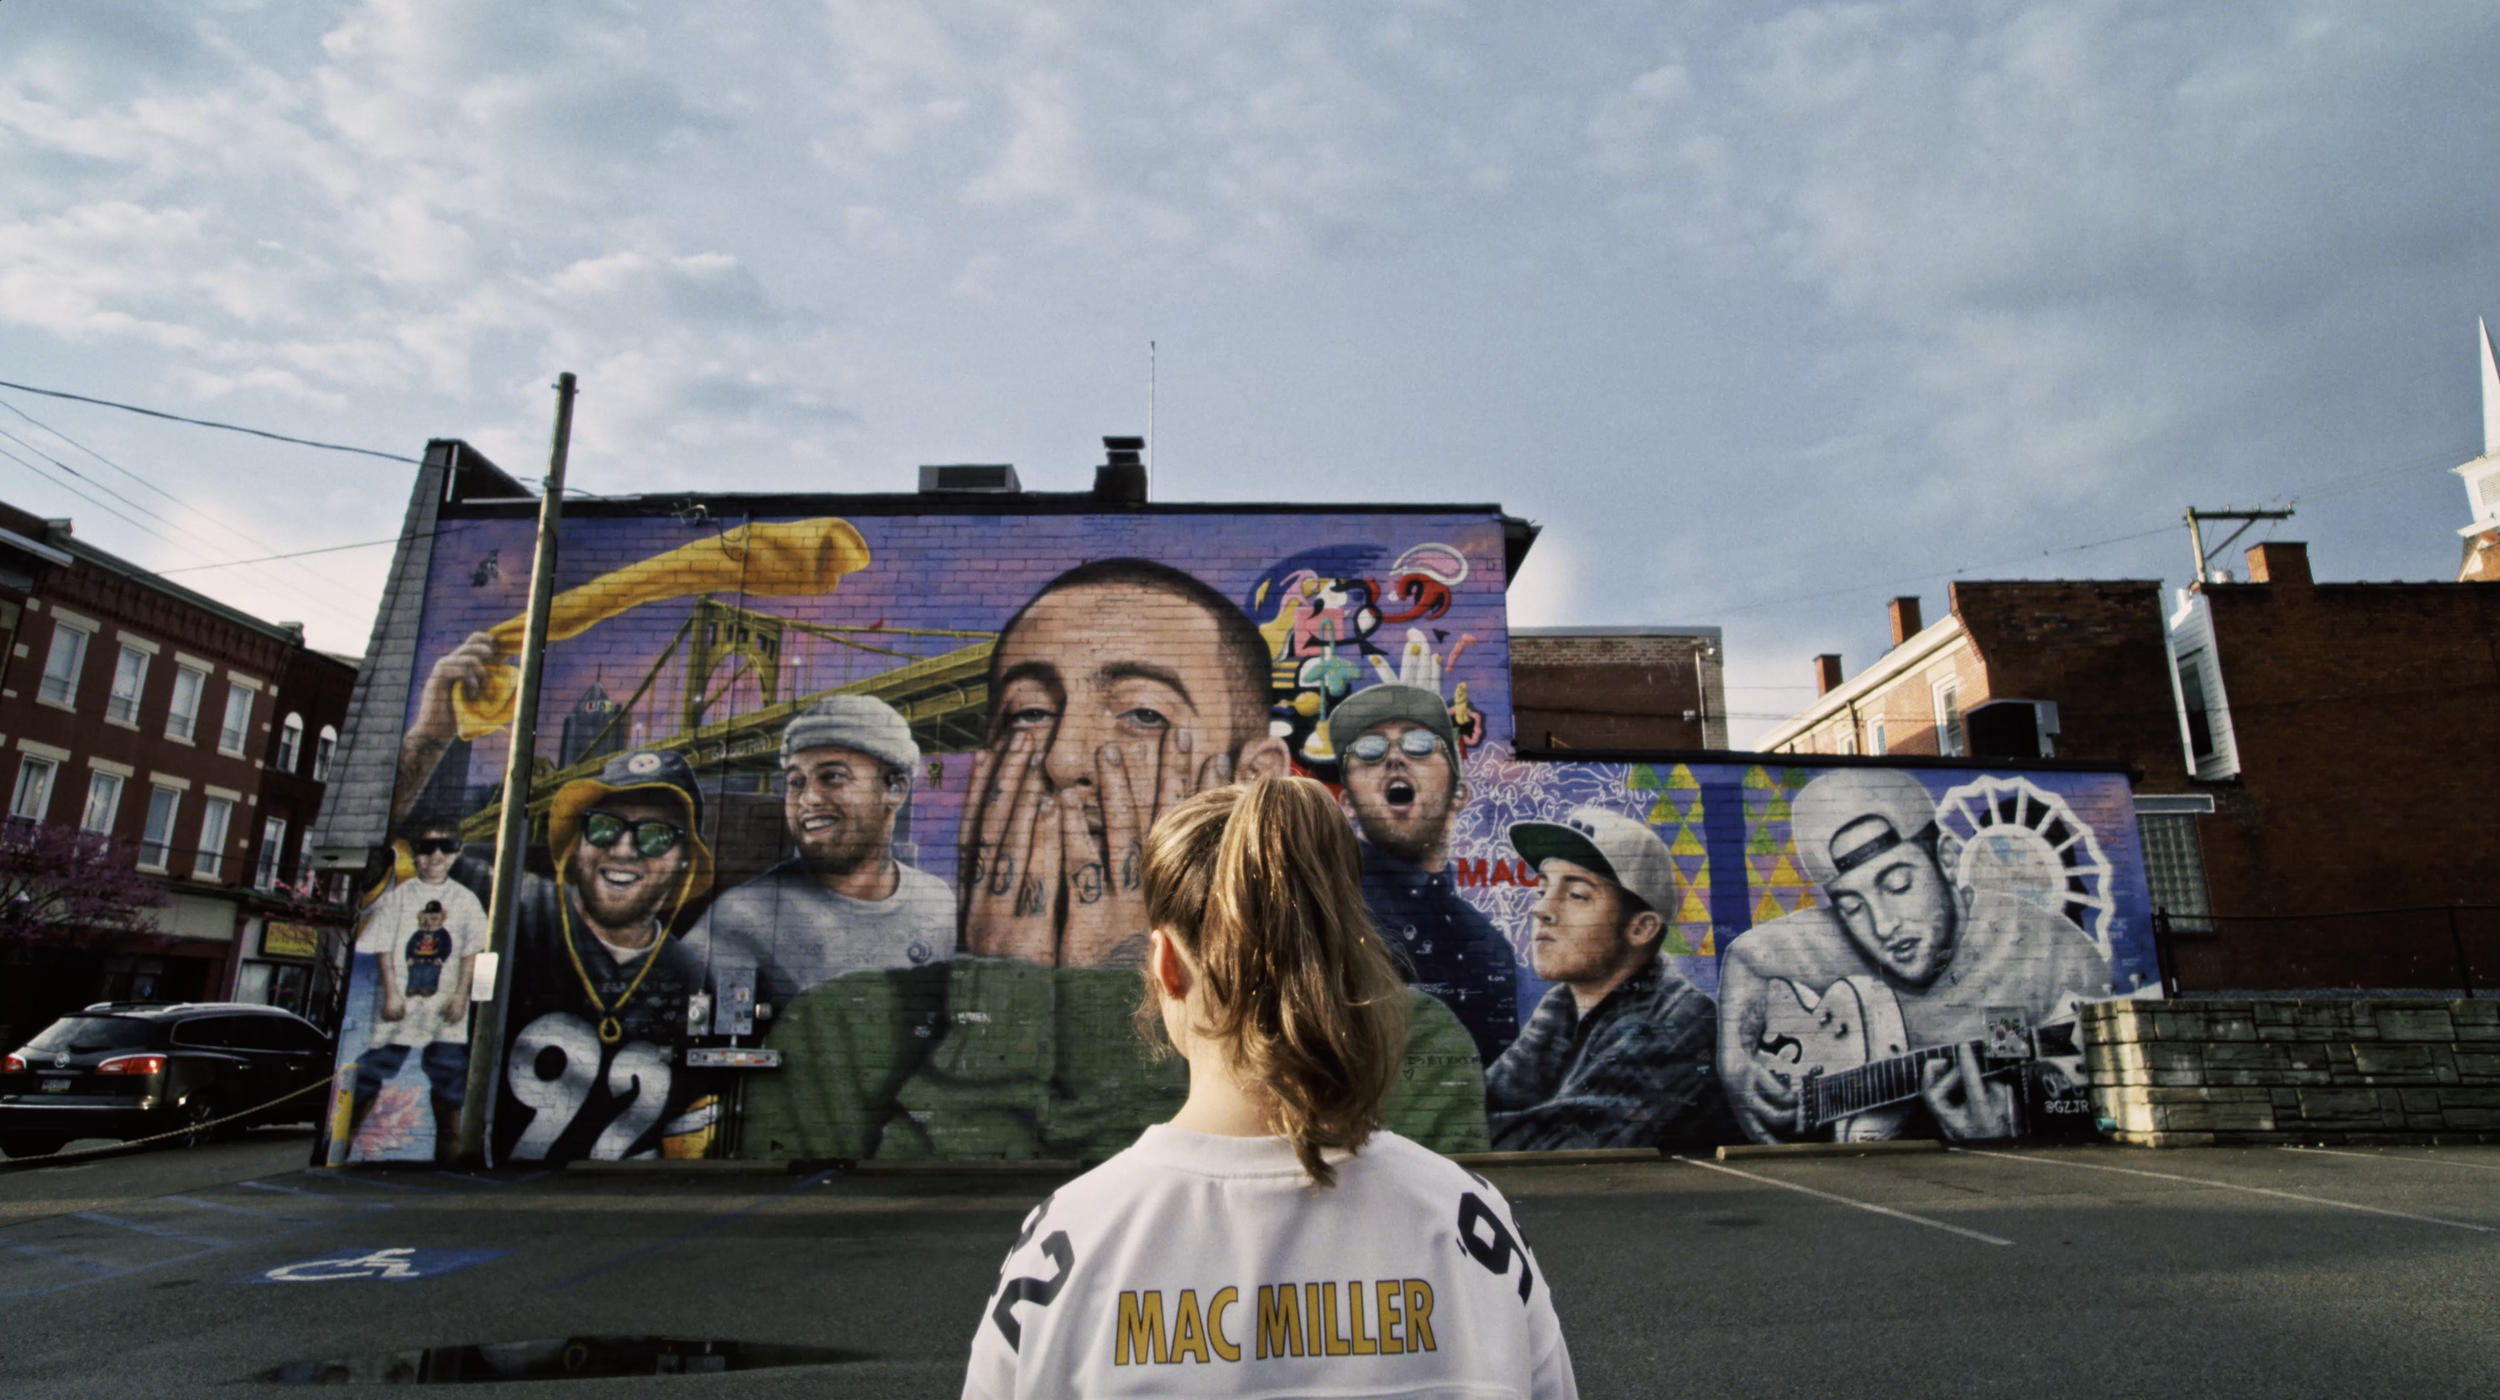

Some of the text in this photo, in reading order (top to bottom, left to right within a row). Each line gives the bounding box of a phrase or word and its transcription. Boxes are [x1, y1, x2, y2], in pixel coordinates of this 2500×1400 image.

[507, 1011, 672, 1160] 92
[1113, 1278, 1438, 1367] MAC MILLER
